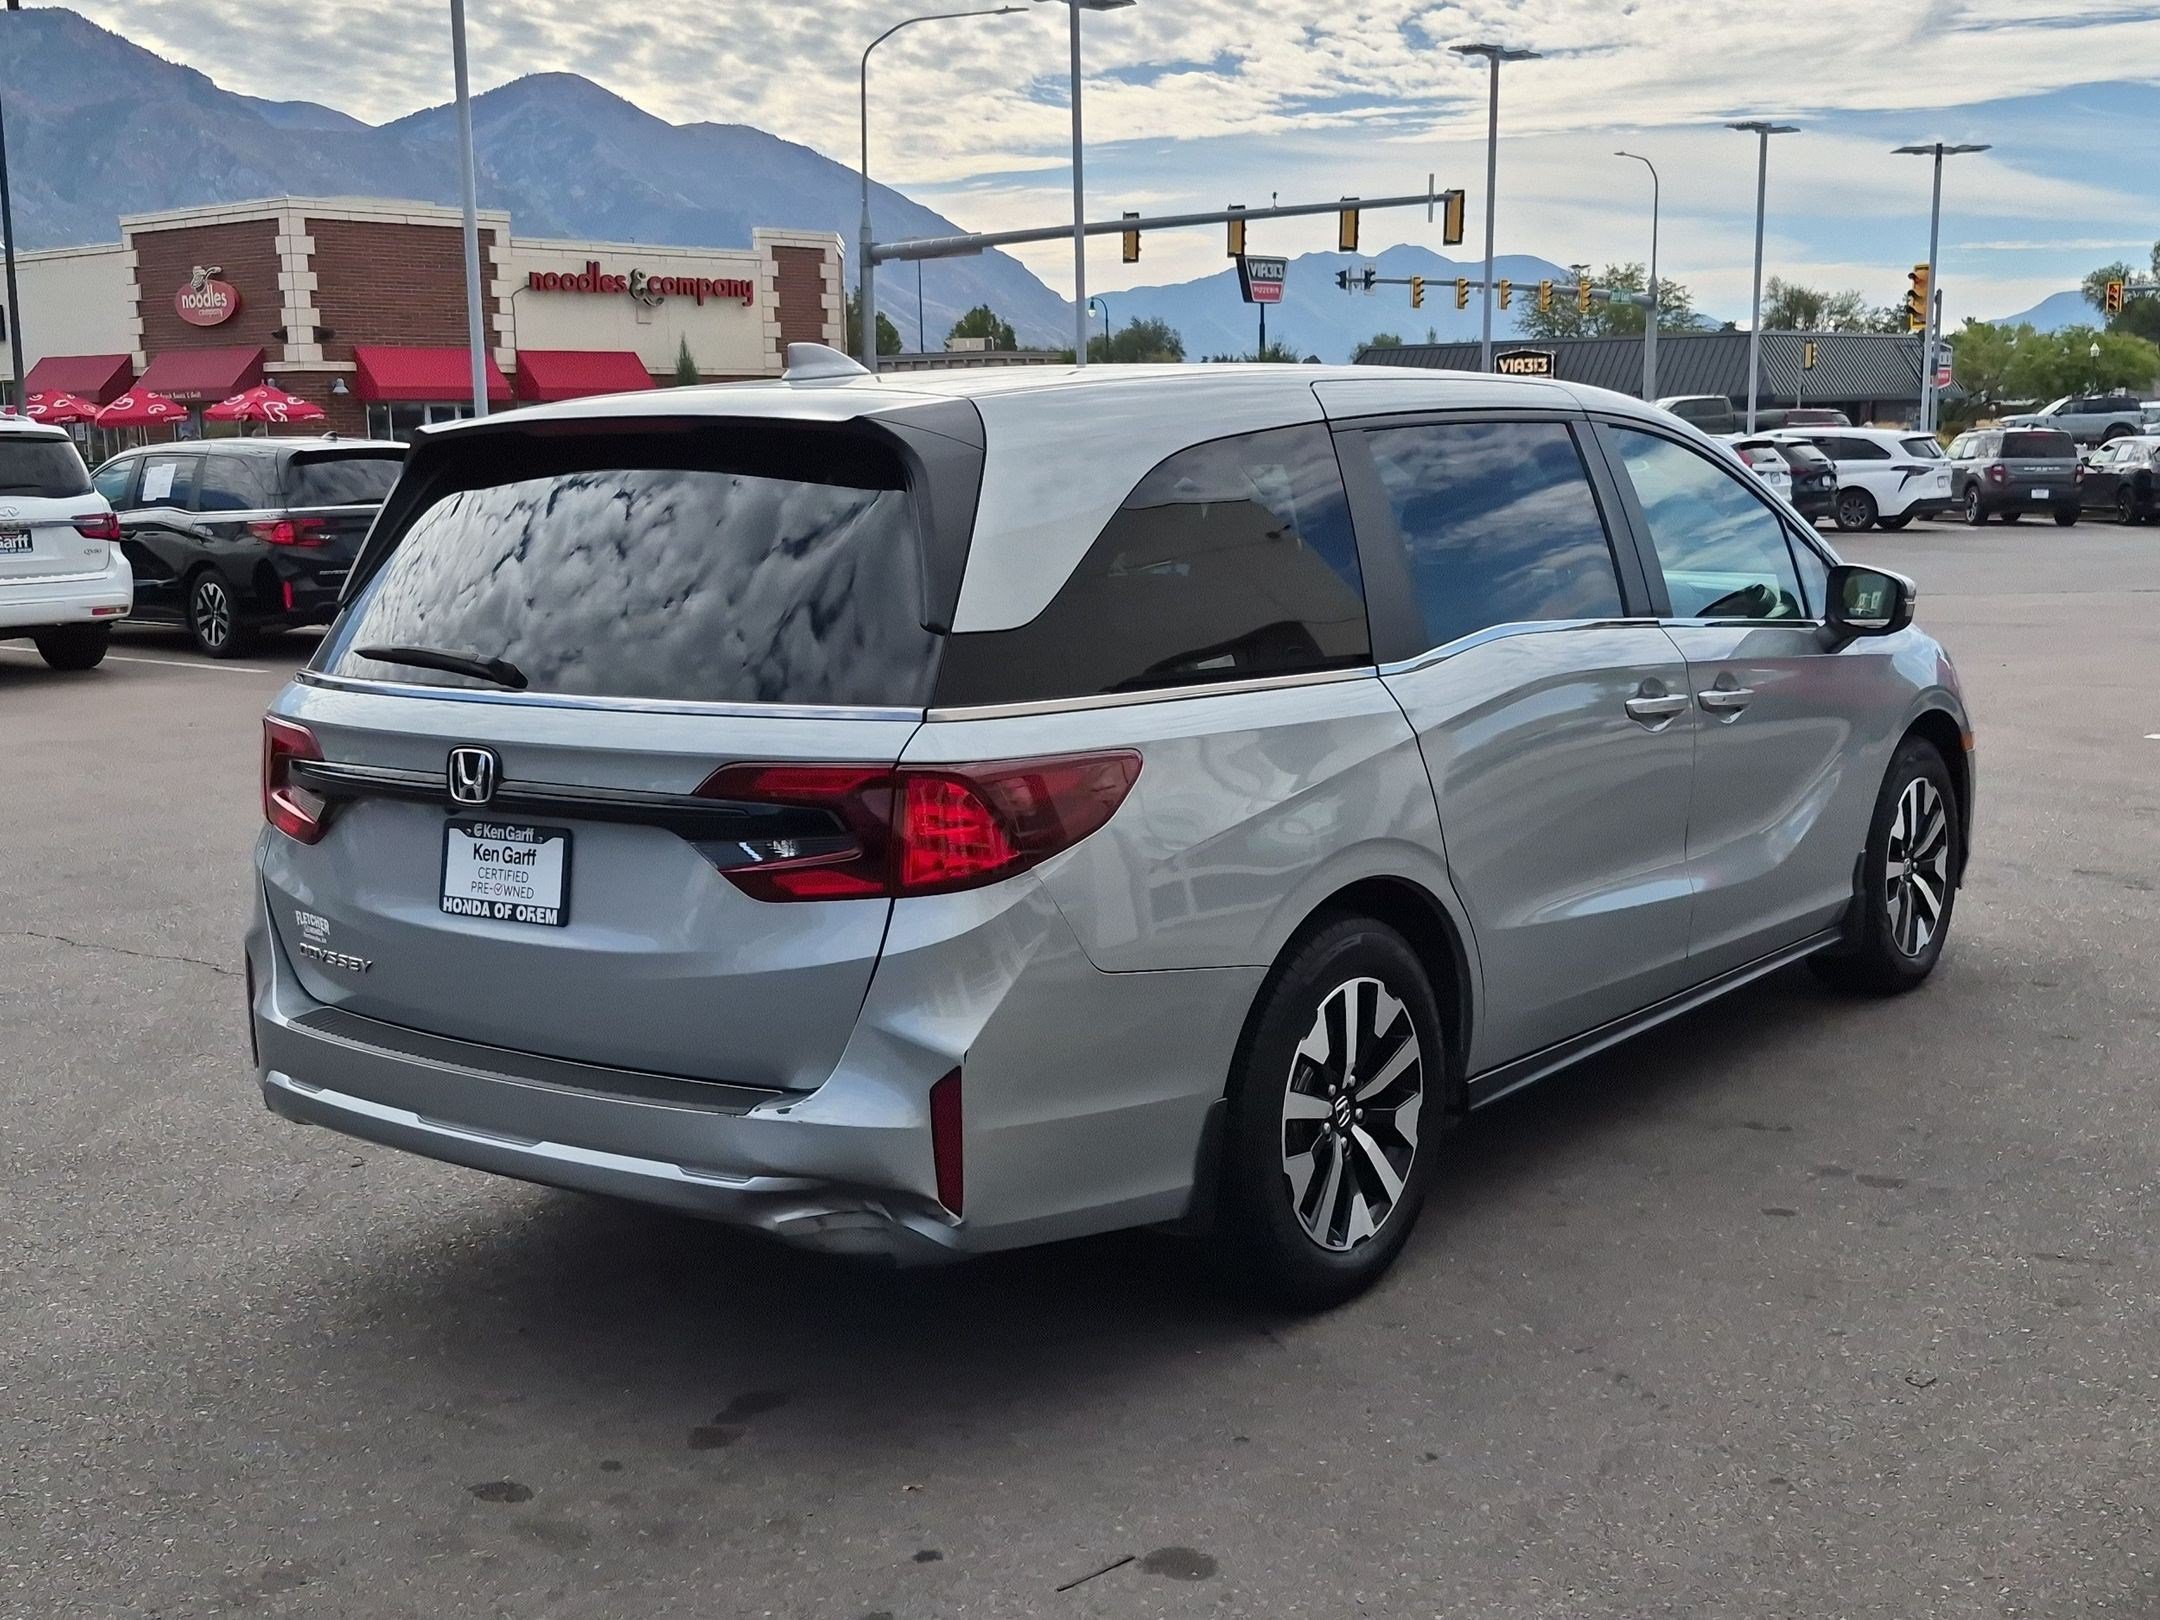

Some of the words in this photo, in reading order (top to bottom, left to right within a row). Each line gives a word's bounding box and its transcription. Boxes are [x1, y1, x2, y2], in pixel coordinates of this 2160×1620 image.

[181, 283, 228, 309] noodles
[529, 261, 627, 293] noodles
[629, 268, 664, 307] &
[647, 275, 754, 307] company
[1499, 357, 1547, 373] VIA313
[483, 824, 505, 839] Ken
[506, 826, 535, 842] Garff
[473, 843, 500, 862] Ken
[502, 846, 537, 866] Garff
[478, 866, 530, 884] CERTIFIED
[443, 897, 491, 918] HONDA
[494, 902, 513, 919] OF
[516, 905, 558, 925] OREM
[299, 942, 373, 974] ODYSSEY
